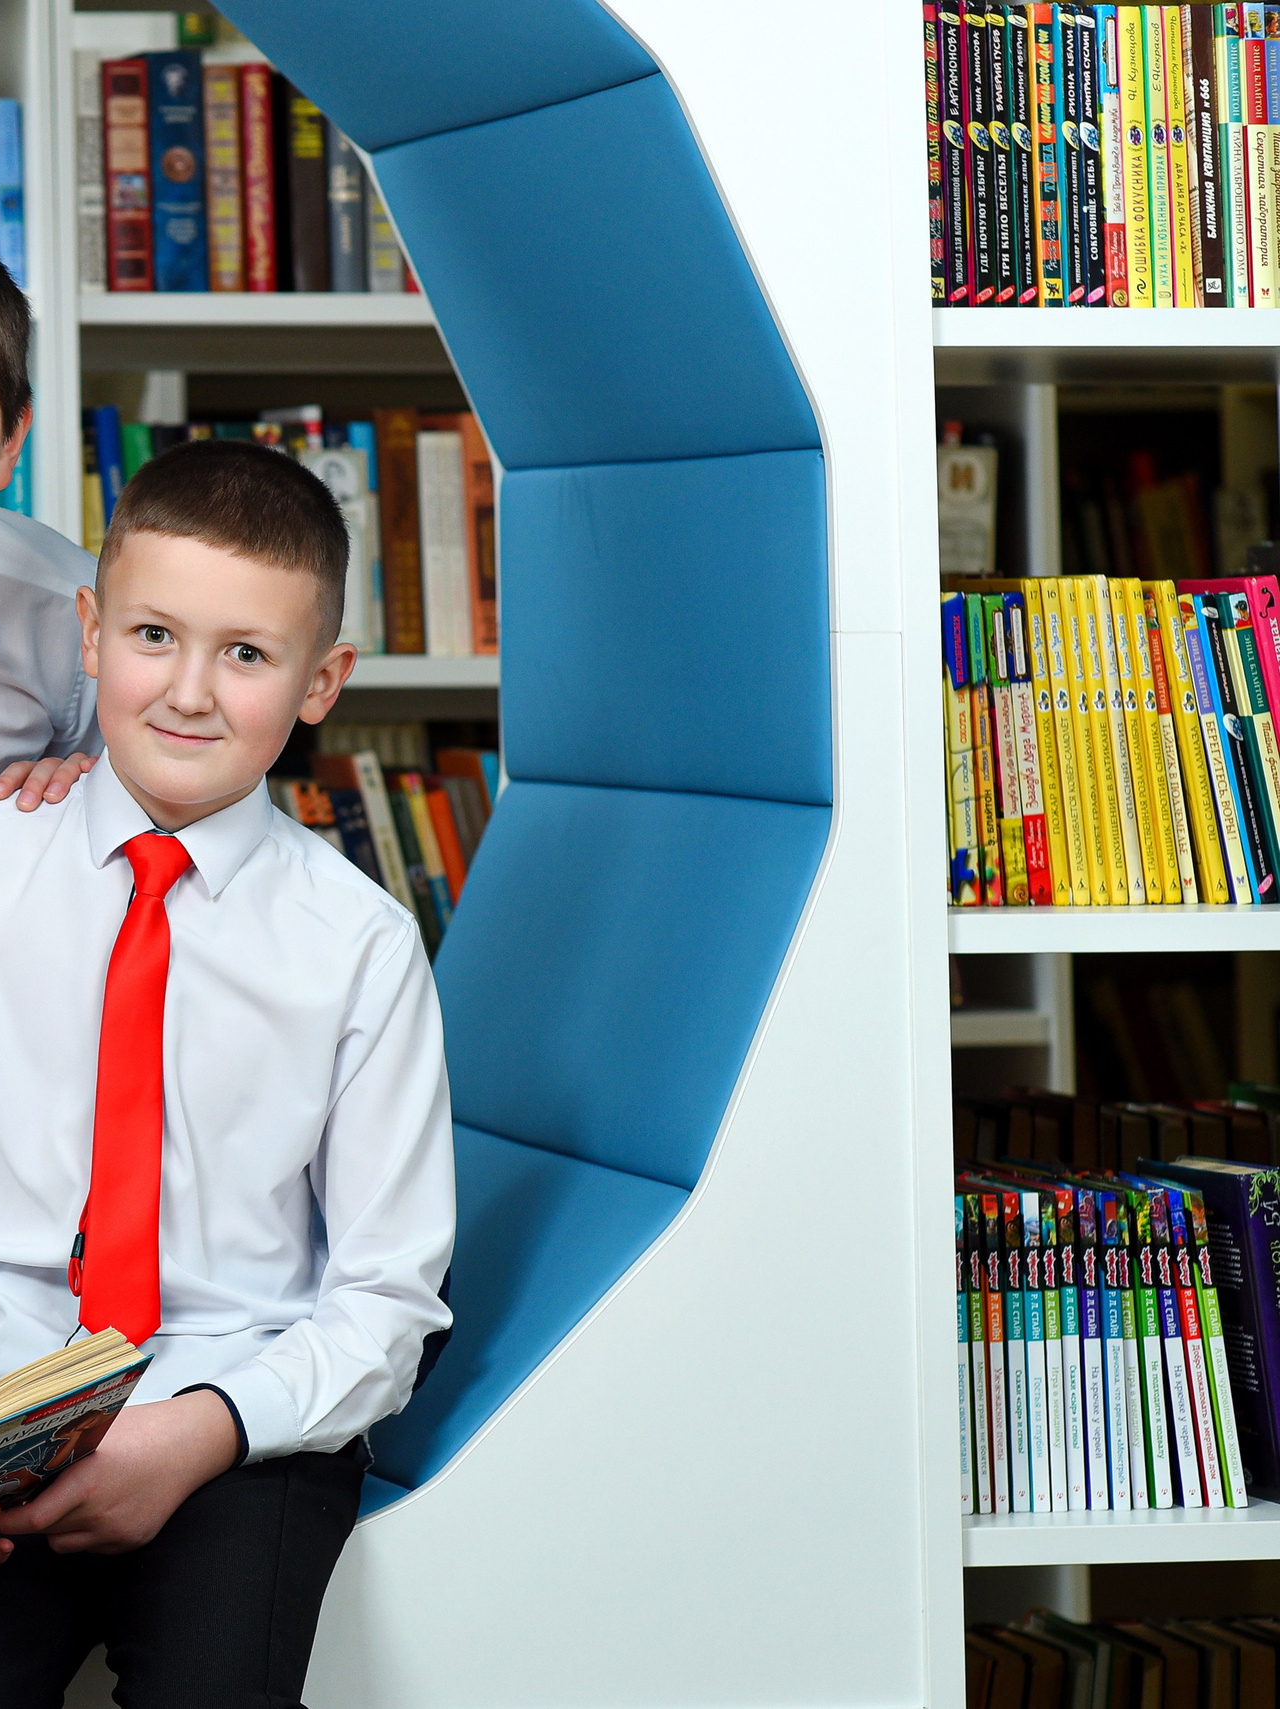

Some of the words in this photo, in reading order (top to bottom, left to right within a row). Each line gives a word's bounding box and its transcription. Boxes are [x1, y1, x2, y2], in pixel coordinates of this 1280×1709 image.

[926, 23, 936, 53] ГОСТЯ
[993, 28, 1001, 58] ГУСЕВ
[1066, 30, 1074, 67] КЕЛЛИ
[1082, 31, 1090, 70] СУСЛИН
[1126, 22, 1138, 84] Кузнецова
[948, 26, 959, 116] Е.АРТАМОНОВА
[974, 31, 982, 84] ДАНИЛОВА
[1230, 44, 1238, 70] ЭНИД
[1252, 45, 1261, 72] ЭНИД
[926, 56, 938, 126] НЕВИДИМОГО
[974, 88, 982, 114] АННА
[994, 61, 1004, 112] ВАЛЕРИЙ
[1039, 58, 1052, 139] АДМИРАЛЬСКОЙ
[1068, 72, 1076, 116] ФИОНА
[1084, 70, 1092, 118] ДМИТРИЙ
[1231, 72, 1240, 116] БЛАЙТОН
[1254, 74, 1262, 118] БЛАЙТОН
[928, 128, 940, 187] ЗАГАДКА
[1201, 112, 1214, 177] КВИТАНЦИЯ
[1233, 130, 1242, 162] ТАЙНА
[1256, 132, 1266, 189] Секретная
[952, 150, 960, 174] ОСОБЫ
[977, 154, 986, 198] ЗЕБРЫ?
[1043, 144, 1056, 193] ТАЙНА
[1087, 159, 1096, 186] НЕБА
[1156, 155, 1166, 192] ПРИЗРАК
[1175, 163, 1183, 179] ДВА
[998, 154, 1008, 210] ВЕСЕЛЬЯ
[1088, 188, 1096, 196] С
[1132, 156, 1146, 222] ФОКУСНИКА
[1176, 182, 1184, 198] ДНЯ
[952, 177, 962, 234] КОРОНОВАННОЙ
[1177, 201, 1185, 212] ДО
[1204, 181, 1217, 238] БАГАЖНАЯ
[1234, 166, 1244, 244] ЗАБРОШЕННОГО
[978, 202, 987, 250] НОЧУЮТ
[1001, 215, 1010, 250] КИЛО
[1088, 198, 1098, 260] СОКРОВИЩЕ
[1156, 196, 1167, 251] ВЛЮБЛЕННЫЙ
[1178, 216, 1186, 236] ЧАСА
[1256, 194, 1268, 267] лаборатория
[954, 237, 962, 252] ДЛЯ
[1025, 240, 1030, 251] ЗА
[1134, 226, 1146, 272] ОШИБКА
[980, 252, 989, 274] ГДЕ
[1002, 253, 1010, 278] ТРИ
[1160, 263, 1168, 286] МУХА
[1236, 248, 1245, 277] ДОМА
[1030, 590, 1038, 600] 17
[1047, 589, 1056, 598] 16
[1086, 590, 1092, 599] 11
[1114, 590, 1123, 599] 12
[1167, 593, 1176, 602] 19
[953, 616, 963, 683] БЕЛОБРЫСЫХ
[1151, 634, 1161, 662] ЭНИД
[1153, 663, 1167, 709] БЛАЙТОН
[1190, 635, 1200, 662] ЭНИД
[1196, 663, 1211, 709] БЛАЙТОН
[1243, 634, 1254, 662] ЭНИД
[1249, 663, 1264, 707] БЛАЙТОН
[959, 711, 967, 744] ОХОТА
[1118, 722, 1128, 758] КРУИЗ
[1261, 721, 1273, 754] Тайна
[1023, 738, 1036, 765] Деда
[1042, 718, 1056, 779] ДЖУНГЛЯХ
[1060, 717, 1076, 794] КОВЁР-САМОЛЁТ
[1084, 728, 1096, 779] ДРАКУЛЫ
[1100, 722, 1112, 781] ВАТИКАНЕ
[1130, 718, 1144, 772] АЛЬГАМБРЫ
[1151, 722, 1163, 772] СЫЩИКА
[1190, 726, 1206, 772] АЛМАЗА
[1206, 720, 1228, 798] БЕРЕГИТЕСЬ,
[1121, 761, 1133, 820] ОПАСНЫЙ
[1137, 773, 1146, 797] РОЗА
[1157, 777, 1170, 821] ПРОТИВ
[1162, 722, 1175, 770] ТАЙНИК
[1170, 782, 1189, 856] ПОДЗЕМЕЛЬЕ
[1198, 773, 1213, 820] СЛЕДАМ
[985, 789, 996, 835] БЛАЙТОН
[1049, 794, 1060, 834] ПОЖАР
[1091, 786, 1099, 820] ГРАФА
[988, 837, 995, 846] Э.
[1070, 795, 1084, 871] РАЗЫСКИВАЕТСЯ
[1093, 825, 1103, 866] СЕКРЕТ
[1108, 795, 1122, 868] ПОХИЩЕНИЕ
[1140, 800, 1156, 872] ТАИНСТВЕННАЯ
[1162, 824, 1175, 868] СЫЩИК
[1207, 825, 1217, 841] ПО
[973, 1311, 981, 1340] СТАЙН
[992, 1312, 1000, 1341] СТАЙН
[1032, 1312, 1040, 1339] СТАЙН
[1048, 1311, 1056, 1339] СТАЙН
[1067, 1306, 1075, 1333] СТАЙН
[1109, 1310, 1118, 1337] СТАЙН
[1146, 1309, 1156, 1336] СТАЙН
[1165, 1309, 1176, 1336] СТАЙН
[1187, 1309, 1198, 1336] СТАЙН
[1209, 1308, 1220, 1335] СТАЙН
[1092, 1366, 1099, 1379] На
[1151, 1361, 1158, 1371] Не
[1174, 1365, 1182, 1378] На
[1192, 1345, 1201, 1370] Добро
[1215, 1347, 1224, 1374] Атака
[1034, 1377, 1042, 1410] Гостья
[1051, 1367, 1059, 1389] Игра
[1196, 1371, 1207, 1418] пожаловать
[1092, 1384, 1100, 1415] крючке
[1151, 1375, 1160, 1416] подходите
[1175, 1381, 1185, 1414] крючке
[1217, 1378, 1233, 1439] чудовищного
[0, 1405, 90, 1445] МУДРЕЦ
[99, 1392, 124, 1406] 05
[1035, 1414, 1042, 1422] из
[1130, 1399, 1140, 1448] невидимку
[1034, 1426, 1043, 1458] глубин
[1092, 1427, 1103, 1459] червей
[1155, 1426, 1164, 1459] подвалу
[1181, 1426, 1192, 1458] червей
[1204, 1427, 1216, 1461] мертвый
[1229, 1442, 1240, 1476] хомяка
[1208, 1463, 1216, 1480] дом
